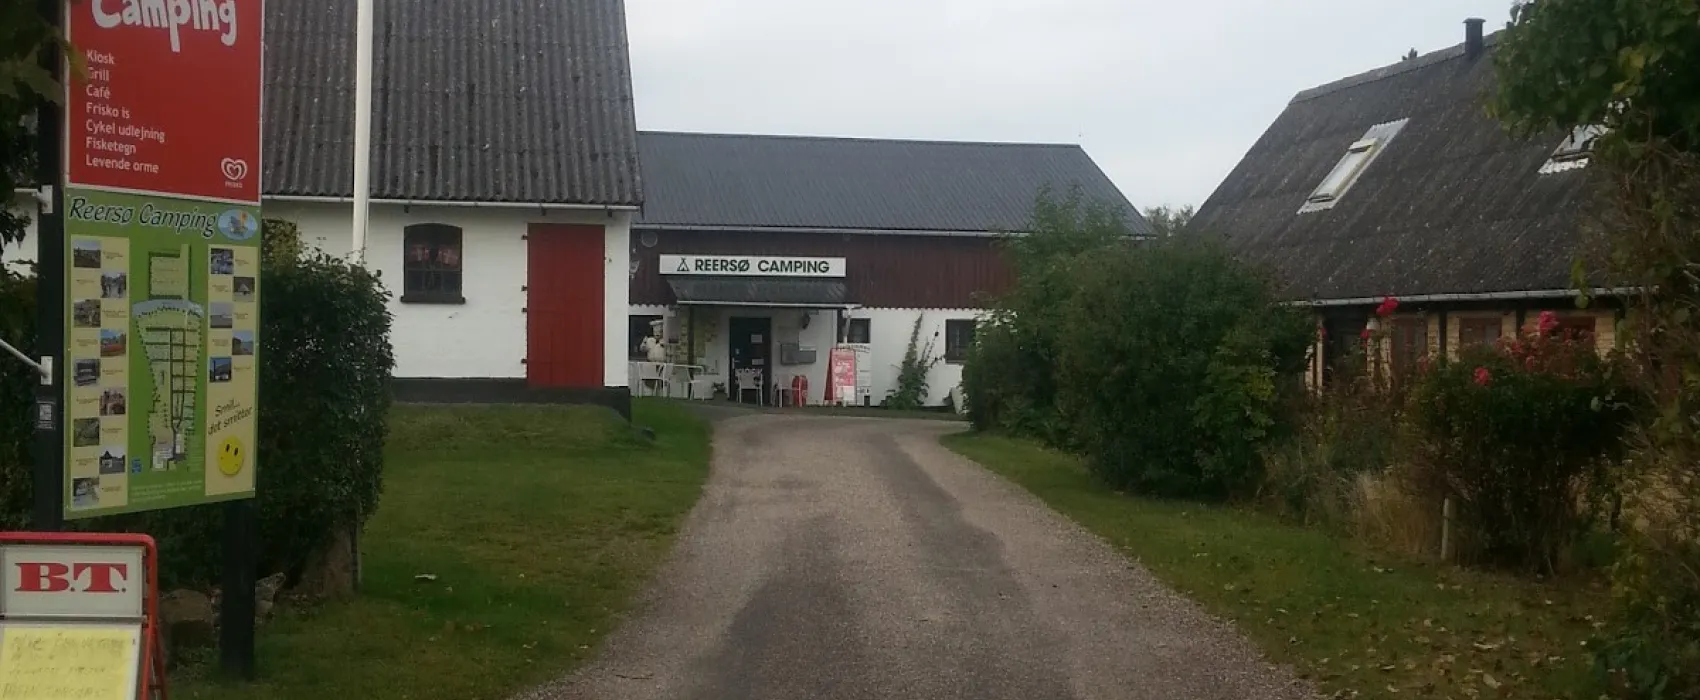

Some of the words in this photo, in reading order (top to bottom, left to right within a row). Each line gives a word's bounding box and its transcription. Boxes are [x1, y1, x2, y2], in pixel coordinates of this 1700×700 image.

[92, 0, 237, 52] Camping
[86, 50, 115, 65] Kiosk
[86, 102, 119, 118] Frisko
[121, 106, 131, 119] is
[86, 119, 116, 135] Cykel
[118, 124, 165, 143] udlejning
[86, 137, 137, 155] Fisketegn
[85, 153, 131, 170] Levende
[133, 162, 159, 174] orme
[139, 203, 217, 237] Camping
[694, 258, 750, 272] REERSØ
[757, 259, 830, 274] CAMPING
[14, 562, 127, 593] B.T.
